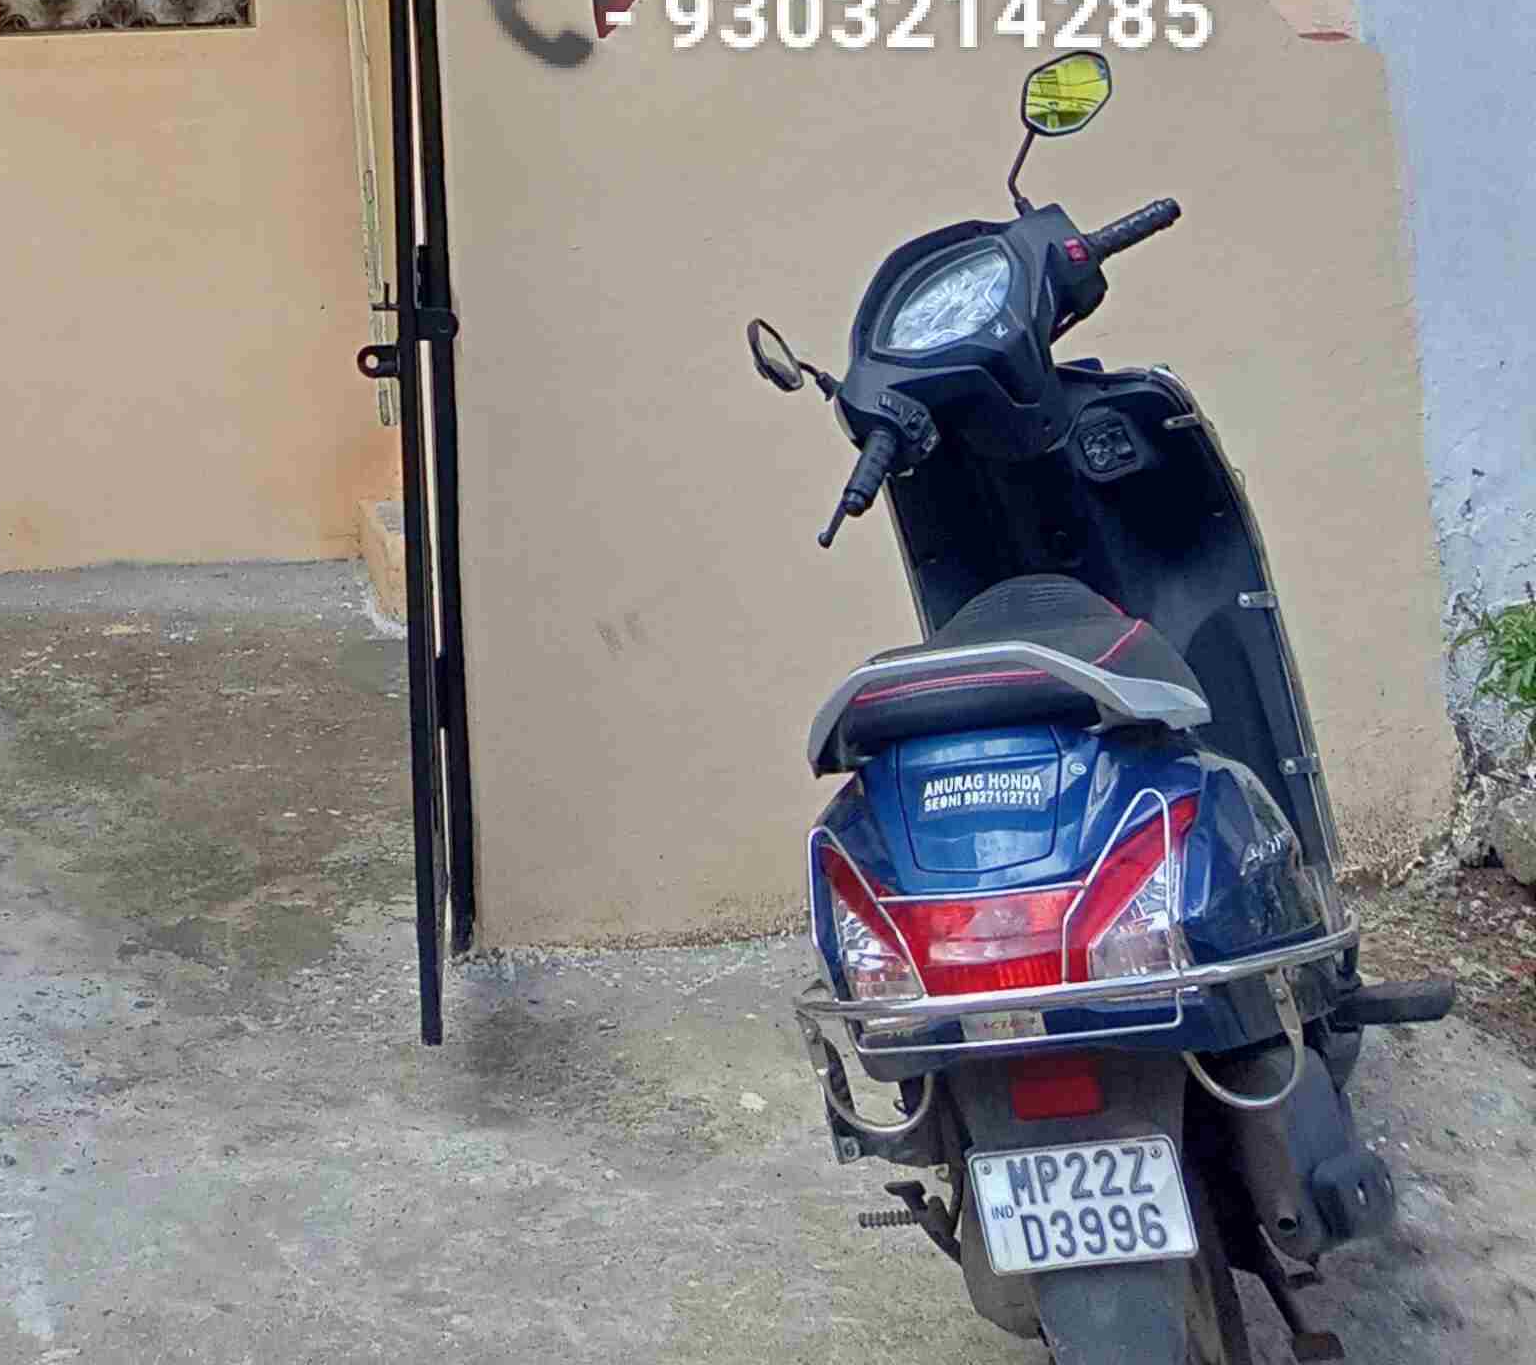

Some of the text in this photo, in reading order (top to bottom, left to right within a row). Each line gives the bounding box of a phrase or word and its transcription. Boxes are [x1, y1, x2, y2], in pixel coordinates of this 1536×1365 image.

[924, 773, 1042, 798] ANURAG HONDA
[991, 1204, 1014, 1219] IND
[1020, 1202, 1168, 1262] D3996
